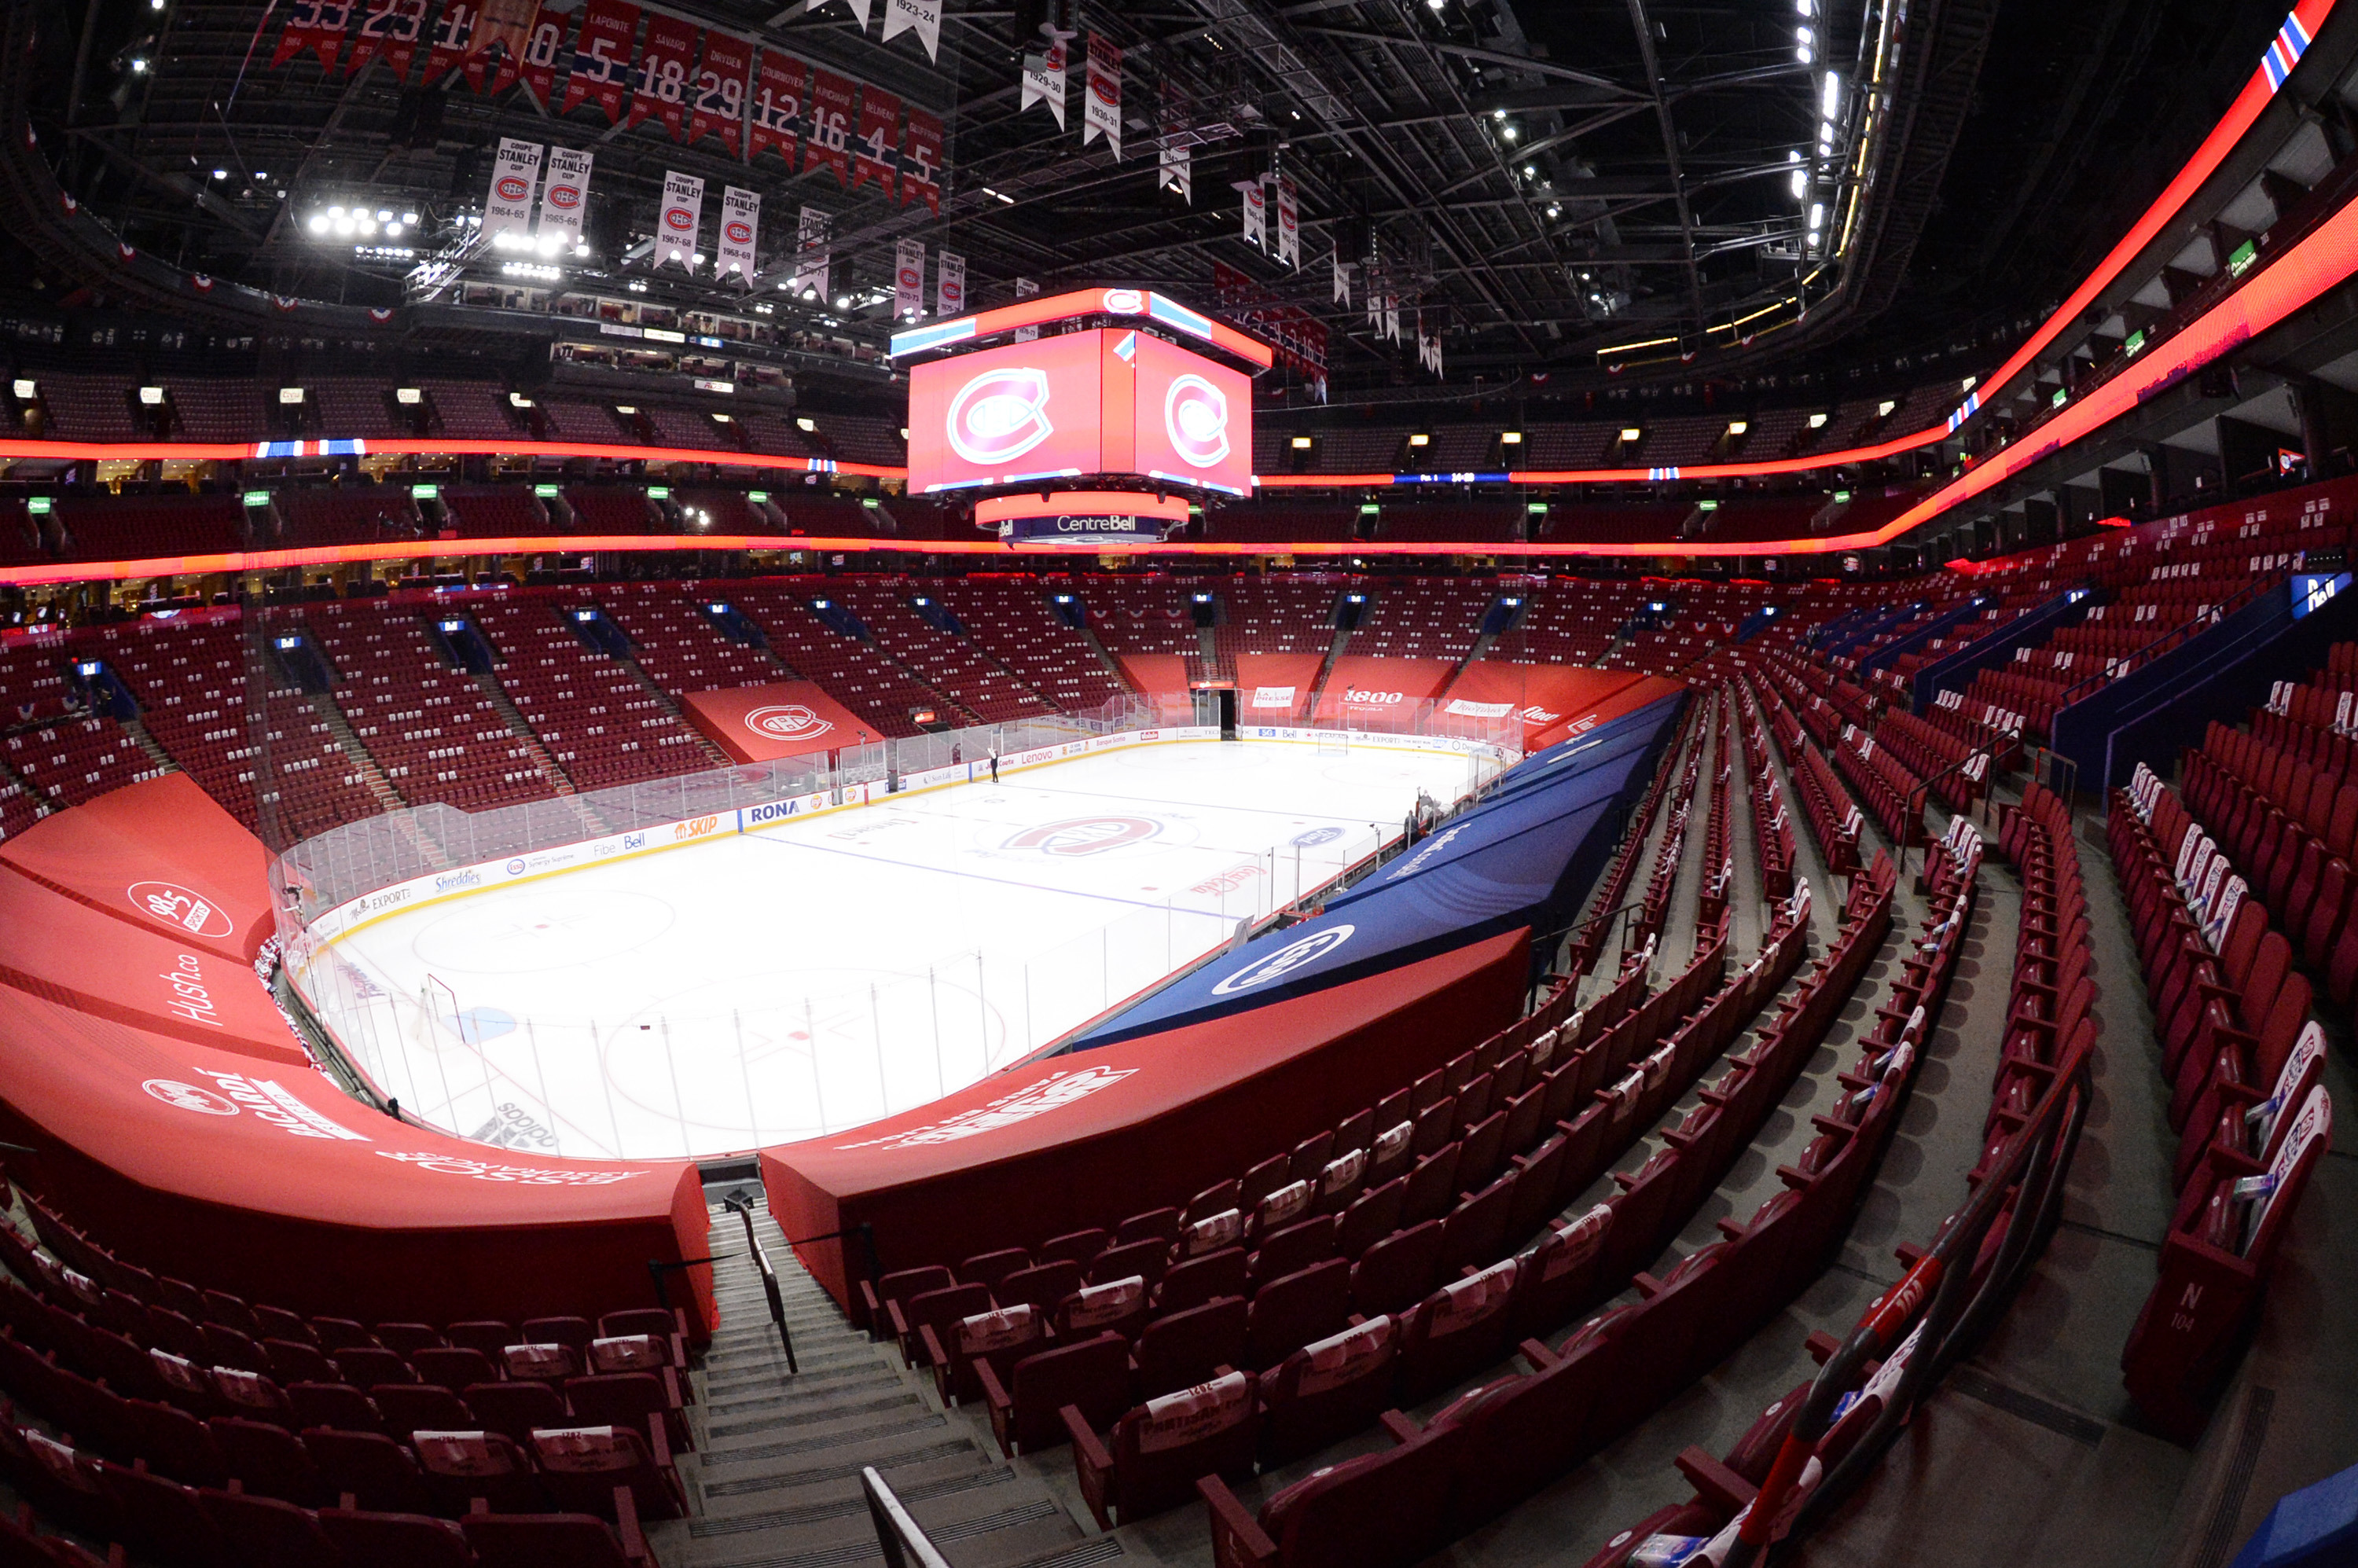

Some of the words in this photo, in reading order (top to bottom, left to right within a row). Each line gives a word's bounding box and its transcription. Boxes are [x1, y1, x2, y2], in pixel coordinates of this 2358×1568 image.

[360, 0, 428, 41] 23
[590, 13, 630, 32] LAPOINTE
[655, 34, 686, 51] SAVARD
[586, 37, 617, 83] 5
[710, 50, 742, 69] DRYDEN
[637, 54, 685, 104] 18
[761, 66, 805, 88] COURNOYER
[1029, 71, 1061, 94] 1929-30
[695, 71, 742, 120] 29
[755, 87, 799, 136] 12
[1091, 105, 1118, 128] 1930-31
[809, 106, 847, 153] 16
[511, 142, 532, 152] COUPE
[866, 126, 886, 166] 4
[499, 149, 539, 166] STANLEY
[550, 157, 590, 174] STANLEY
[561, 151, 583, 161] COUPE
[914, 144, 932, 184] 5
[666, 181, 701, 198] STANLEY
[675, 175, 695, 185] COUPE
[491, 205, 525, 219] 1964-65
[725, 196, 758, 213] STANLEY
[545, 213, 577, 226] 1965-66
[662, 233, 691, 248] 1967-68
[723, 246, 751, 260] 1968-69
[898, 245, 924, 260] STANLEY
[940, 260, 964, 274] STANLEY
[1057, 515, 1136, 531] CentreBell
[1344, 689, 1403, 704] 1800
[1282, 729, 1297, 738] Bell
[1022, 750, 1052, 765] Lenovo
[751, 800, 799, 822] RONA
[689, 816, 718, 838] SKIP
[594, 843, 615, 857] Fibe
[624, 833, 645, 850] Bell
[435, 869, 480, 892] Shreddies
[147, 890, 191, 919] 98.5
[372, 888, 407, 910] EXPORT
[189, 902, 210, 931] SPORTS
[159, 954, 222, 1026] Hush.ca
[987, 1070, 1067, 1107] PARIS
[498, 1102, 555, 1148] adidas
[939, 1108, 985, 1125] EN
[2180, 1281, 2204, 1309] N
[2170, 1312, 2195, 1332] 104
[1188, 1383, 1213, 1397] 2021
